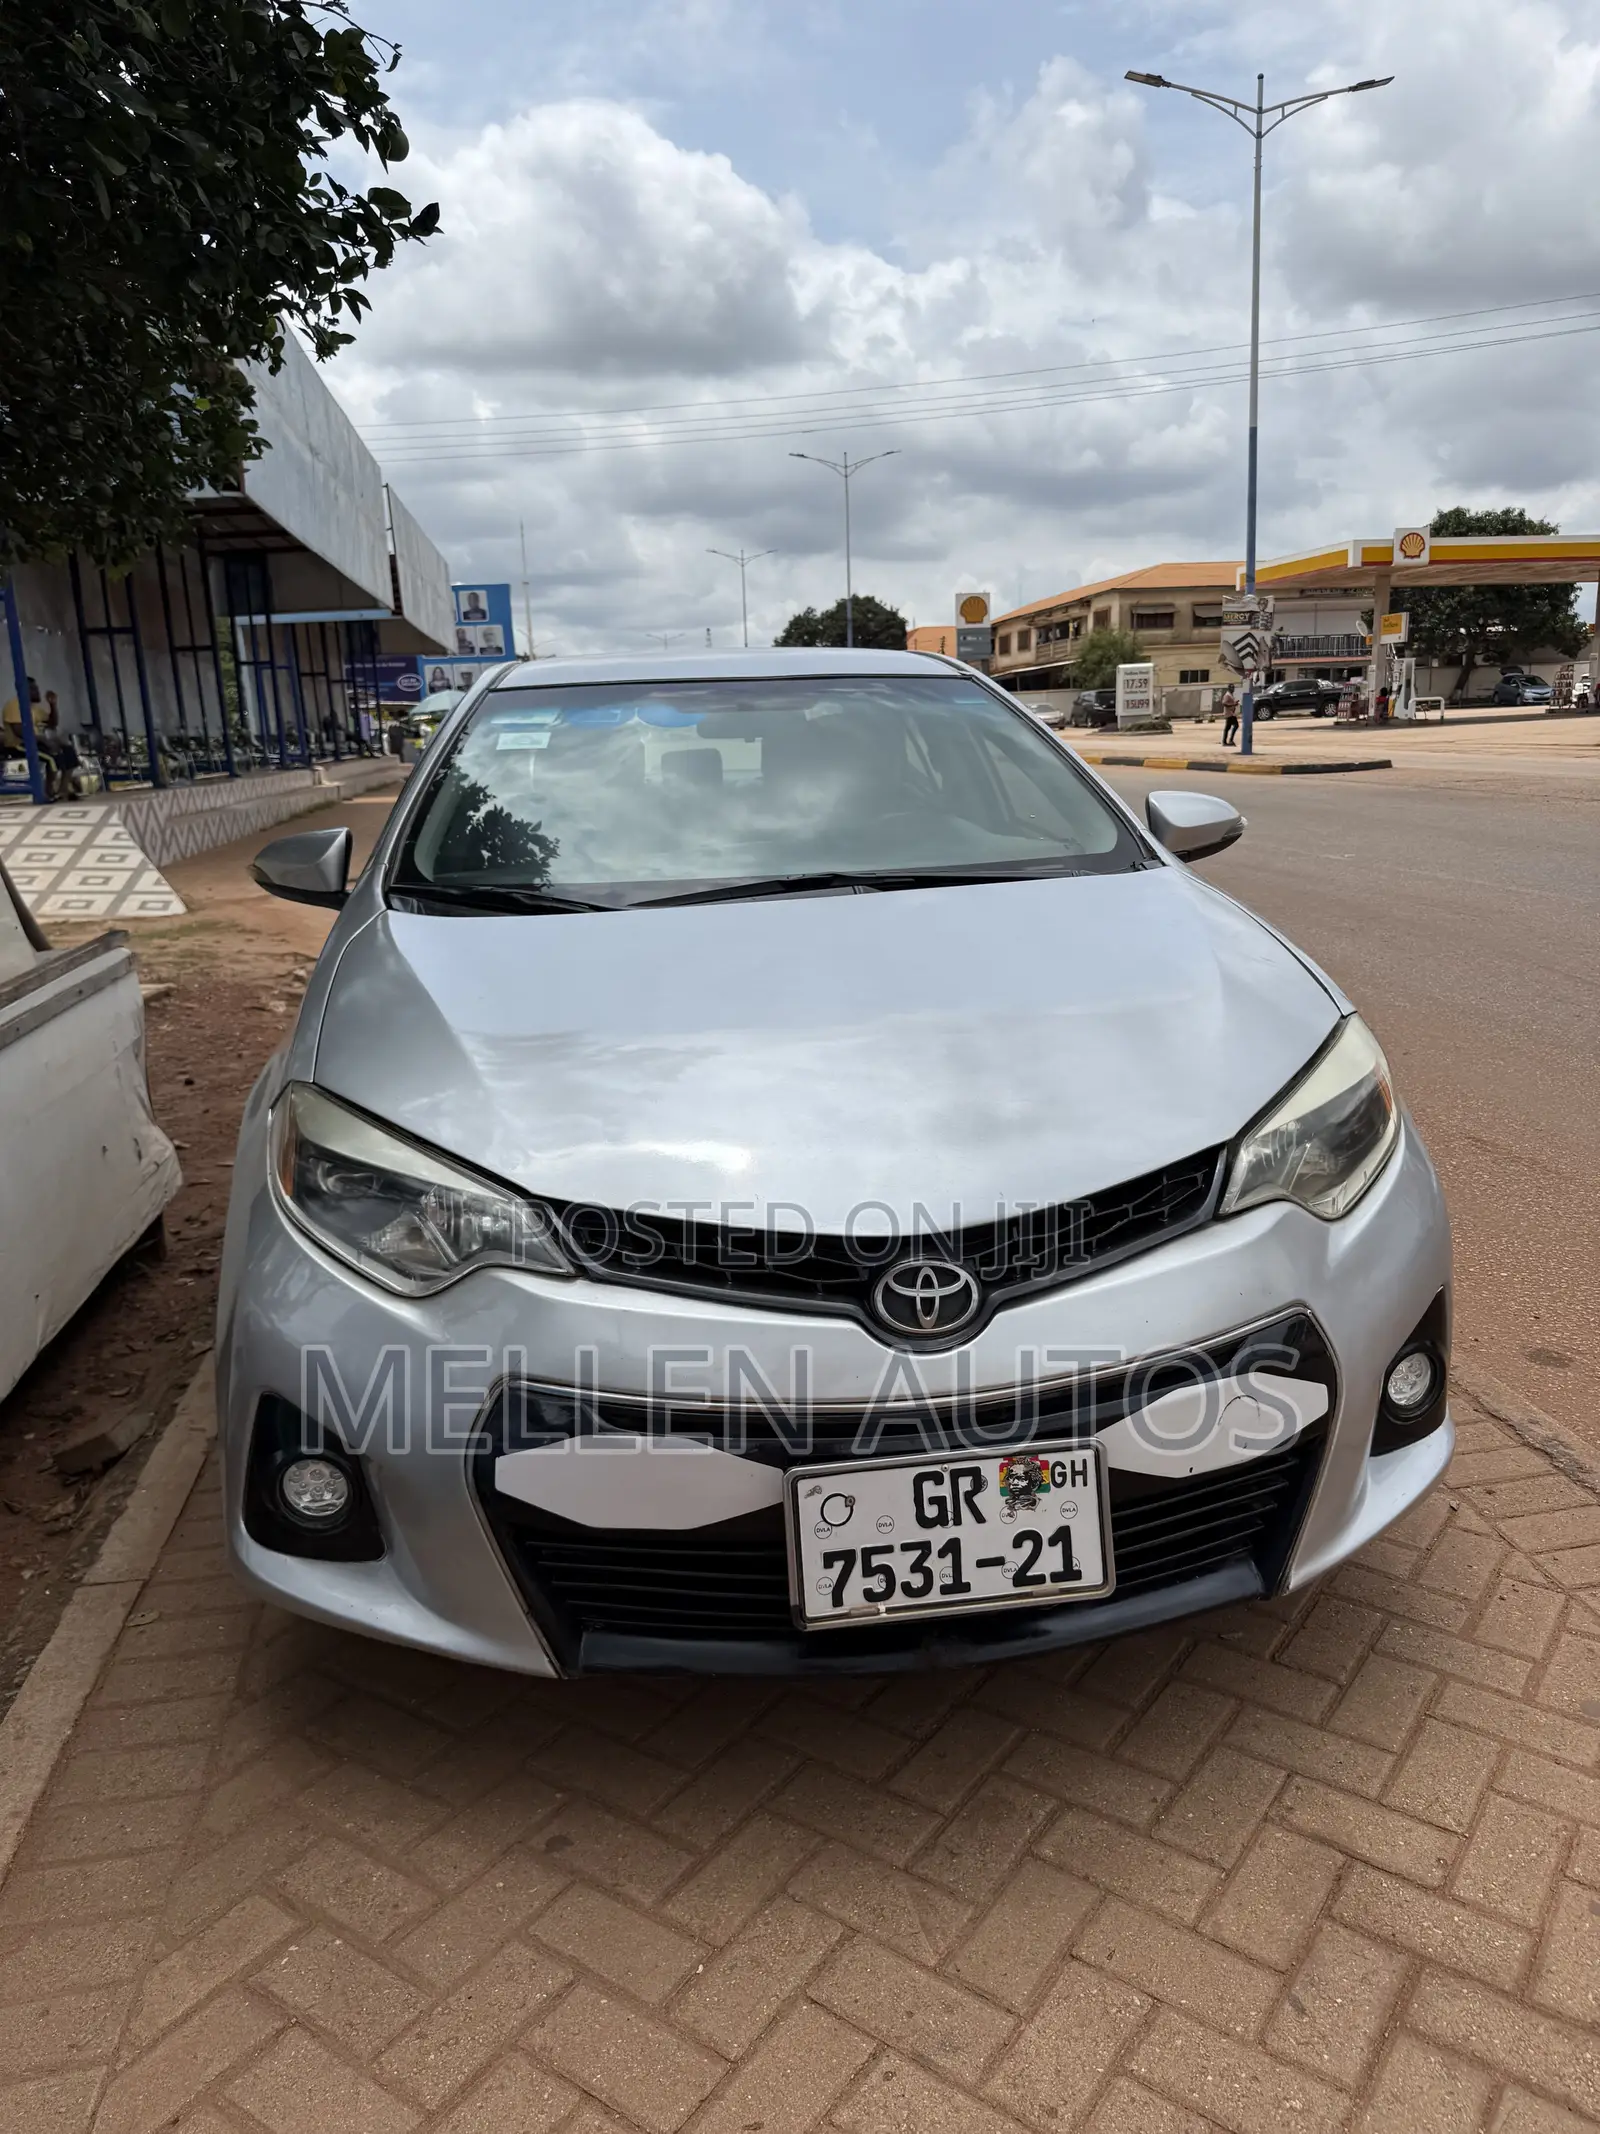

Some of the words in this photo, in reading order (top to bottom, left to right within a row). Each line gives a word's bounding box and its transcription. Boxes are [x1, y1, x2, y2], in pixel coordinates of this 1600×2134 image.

[913, 1465, 986, 1528] GR
[1050, 1458, 1088, 1488] GH
[822, 1525, 1083, 1608] 7531-21
